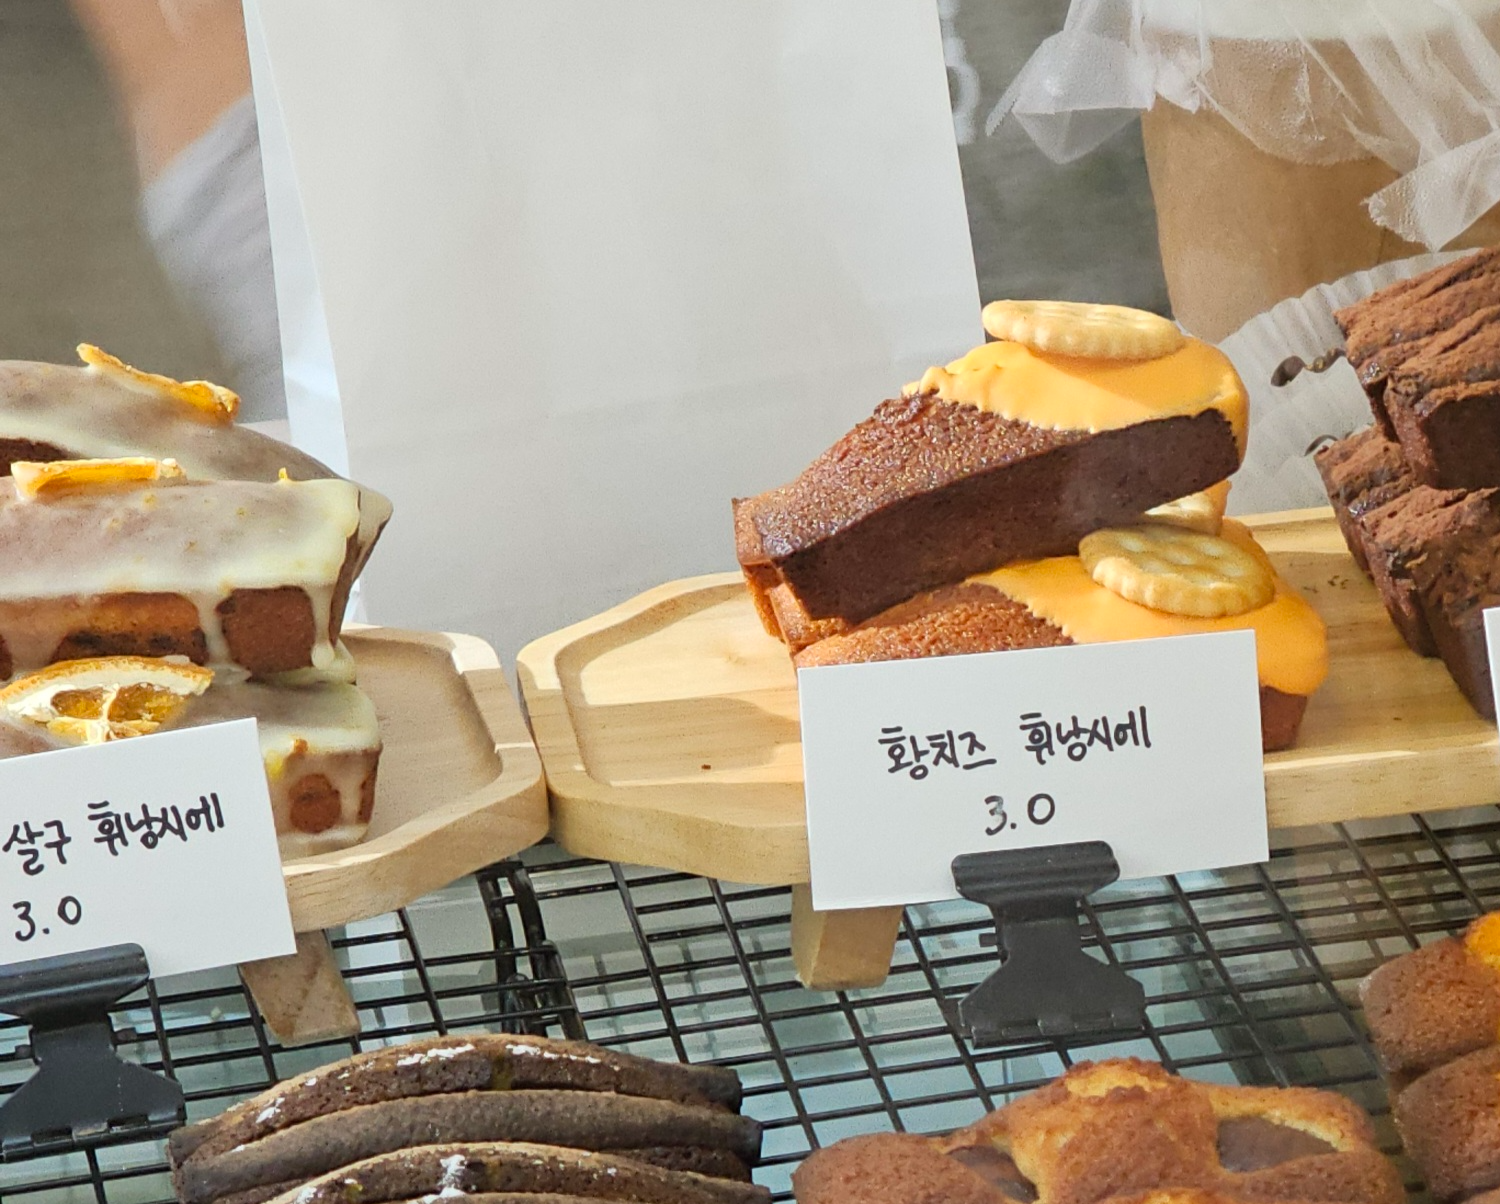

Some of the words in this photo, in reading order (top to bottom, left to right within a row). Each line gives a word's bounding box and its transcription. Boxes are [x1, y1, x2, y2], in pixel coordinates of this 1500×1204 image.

[877, 725, 998, 781] 황치즈
[1019, 705, 1152, 766] 휘낭시에
[1, 819, 72, 877] 살구
[87, 792, 225, 857] 휘낭시에
[984, 792, 1056, 837] 3.0
[12, 895, 82, 942] 3.0
